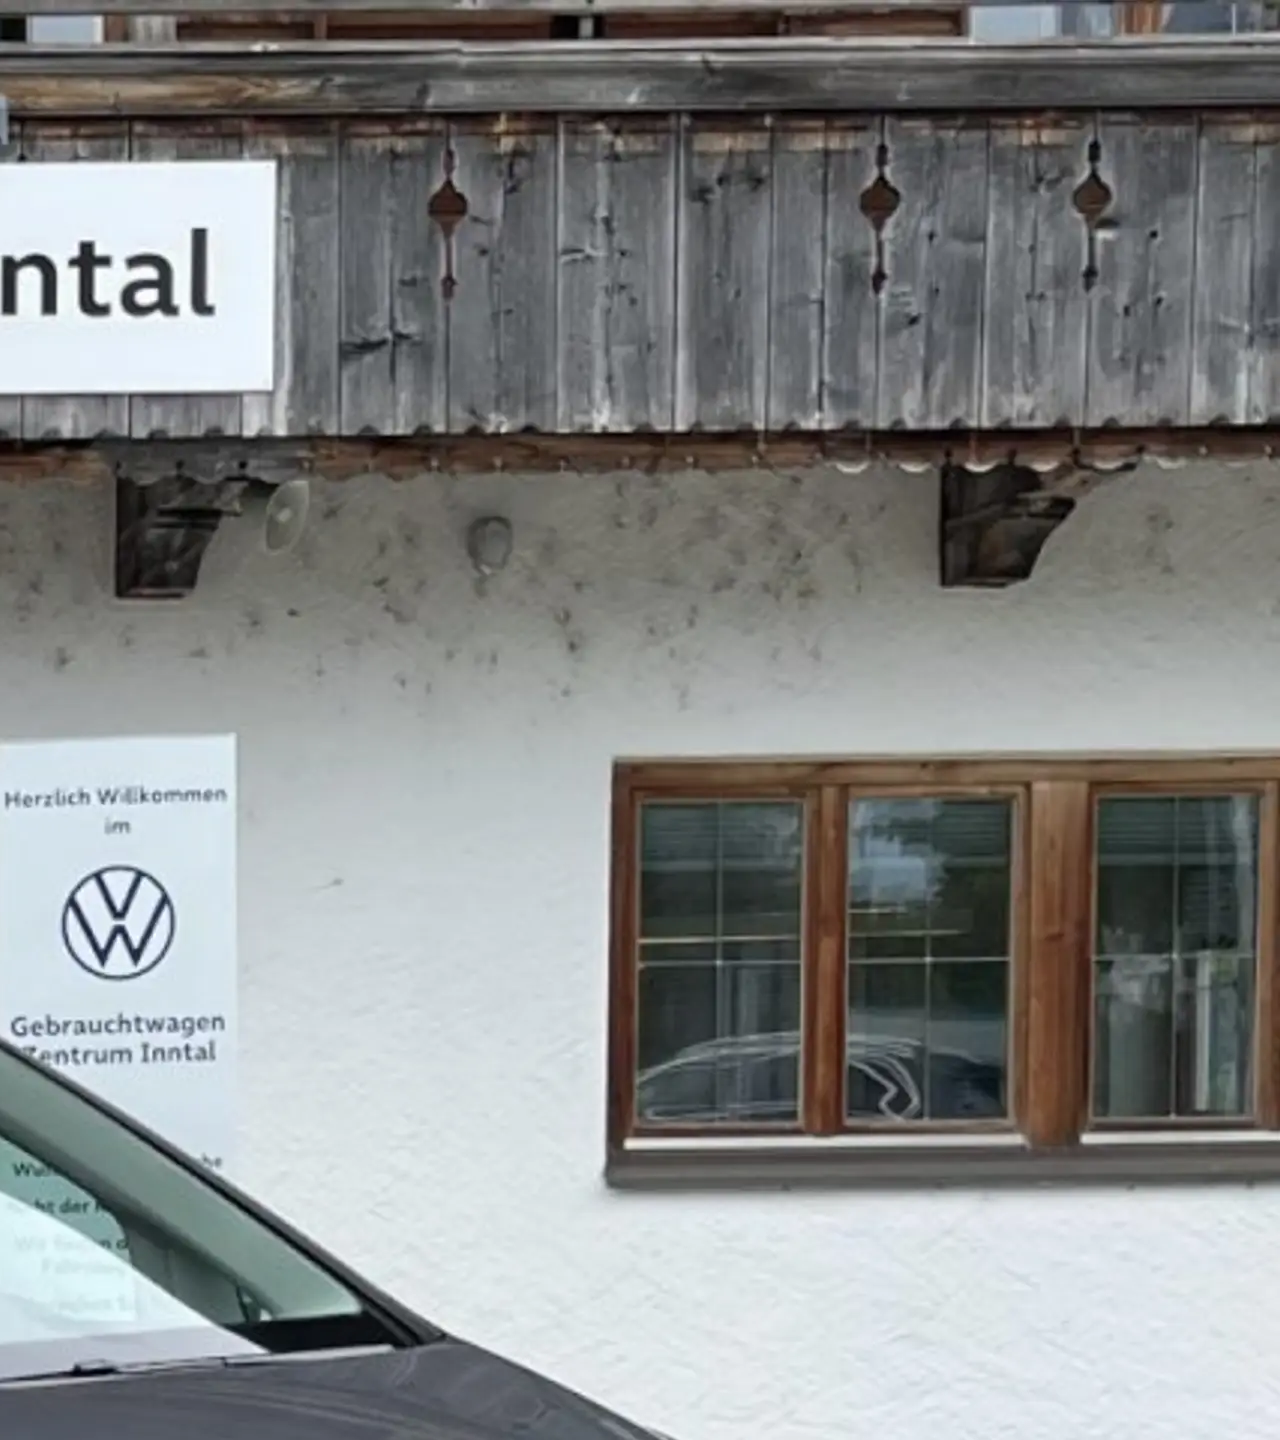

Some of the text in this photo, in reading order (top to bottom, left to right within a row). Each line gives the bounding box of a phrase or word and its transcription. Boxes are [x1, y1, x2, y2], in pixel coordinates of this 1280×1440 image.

[4, 784, 228, 809] Herzlich Willkommen
[104, 817, 132, 835] im
[10, 1011, 226, 1040] Gebrauchtwagen
[141, 1040, 217, 1065] Inntal
